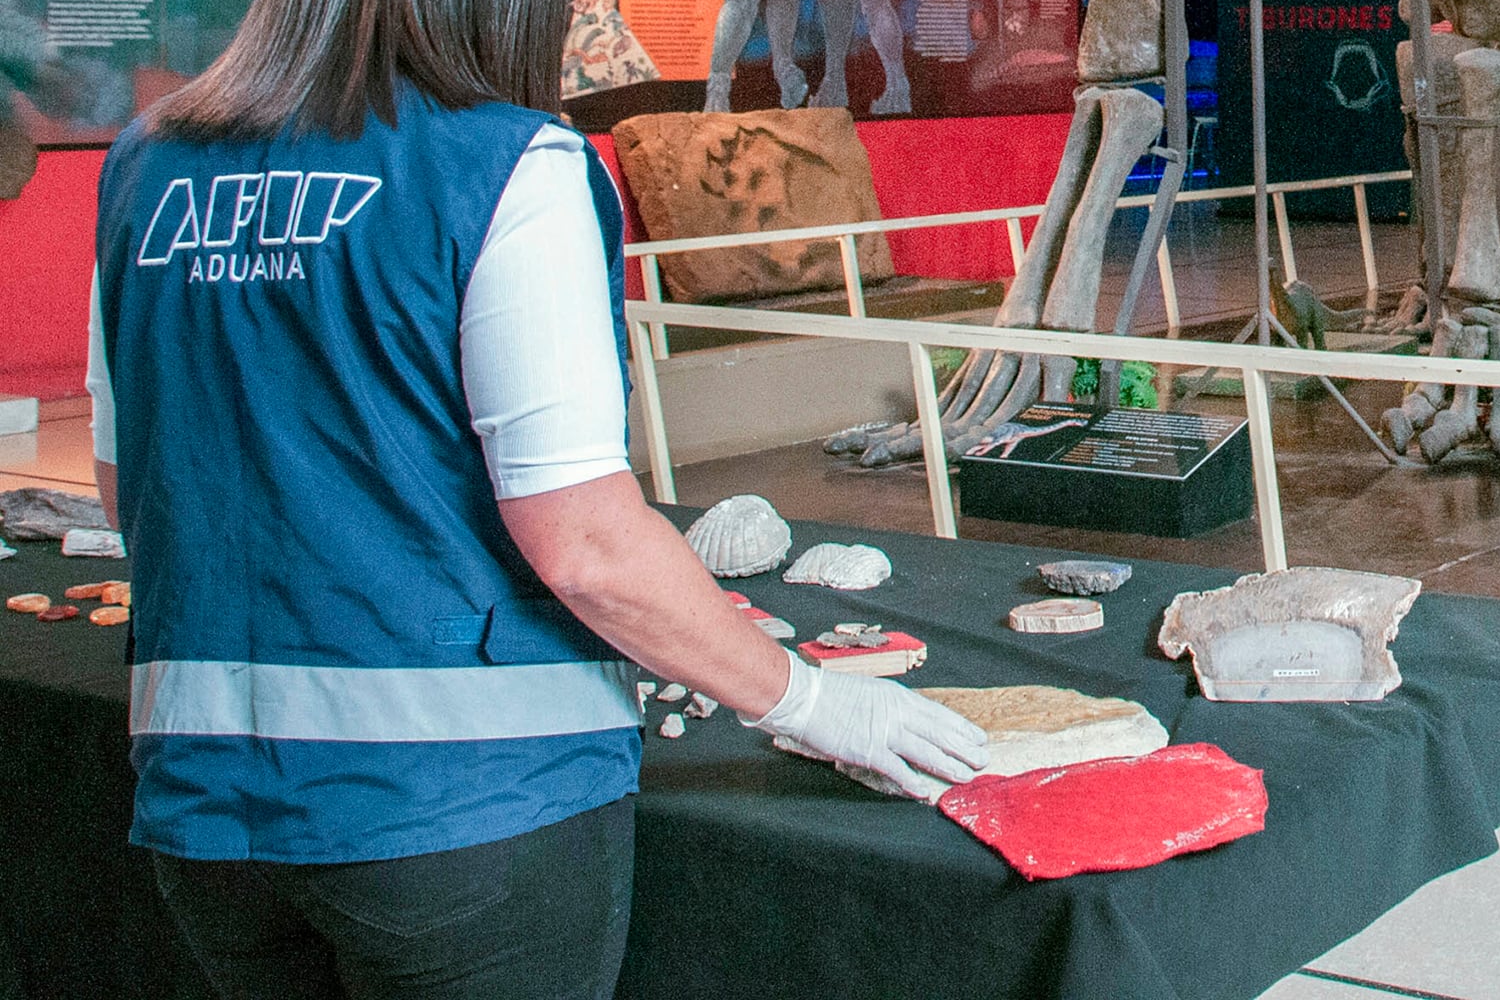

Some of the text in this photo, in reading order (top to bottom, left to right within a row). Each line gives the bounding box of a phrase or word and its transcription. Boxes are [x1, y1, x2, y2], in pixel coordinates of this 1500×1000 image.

[1234, 5, 1393, 31] TBURONES
[137, 171, 383, 266] AFIP
[188, 252, 306, 284] ADUANA
